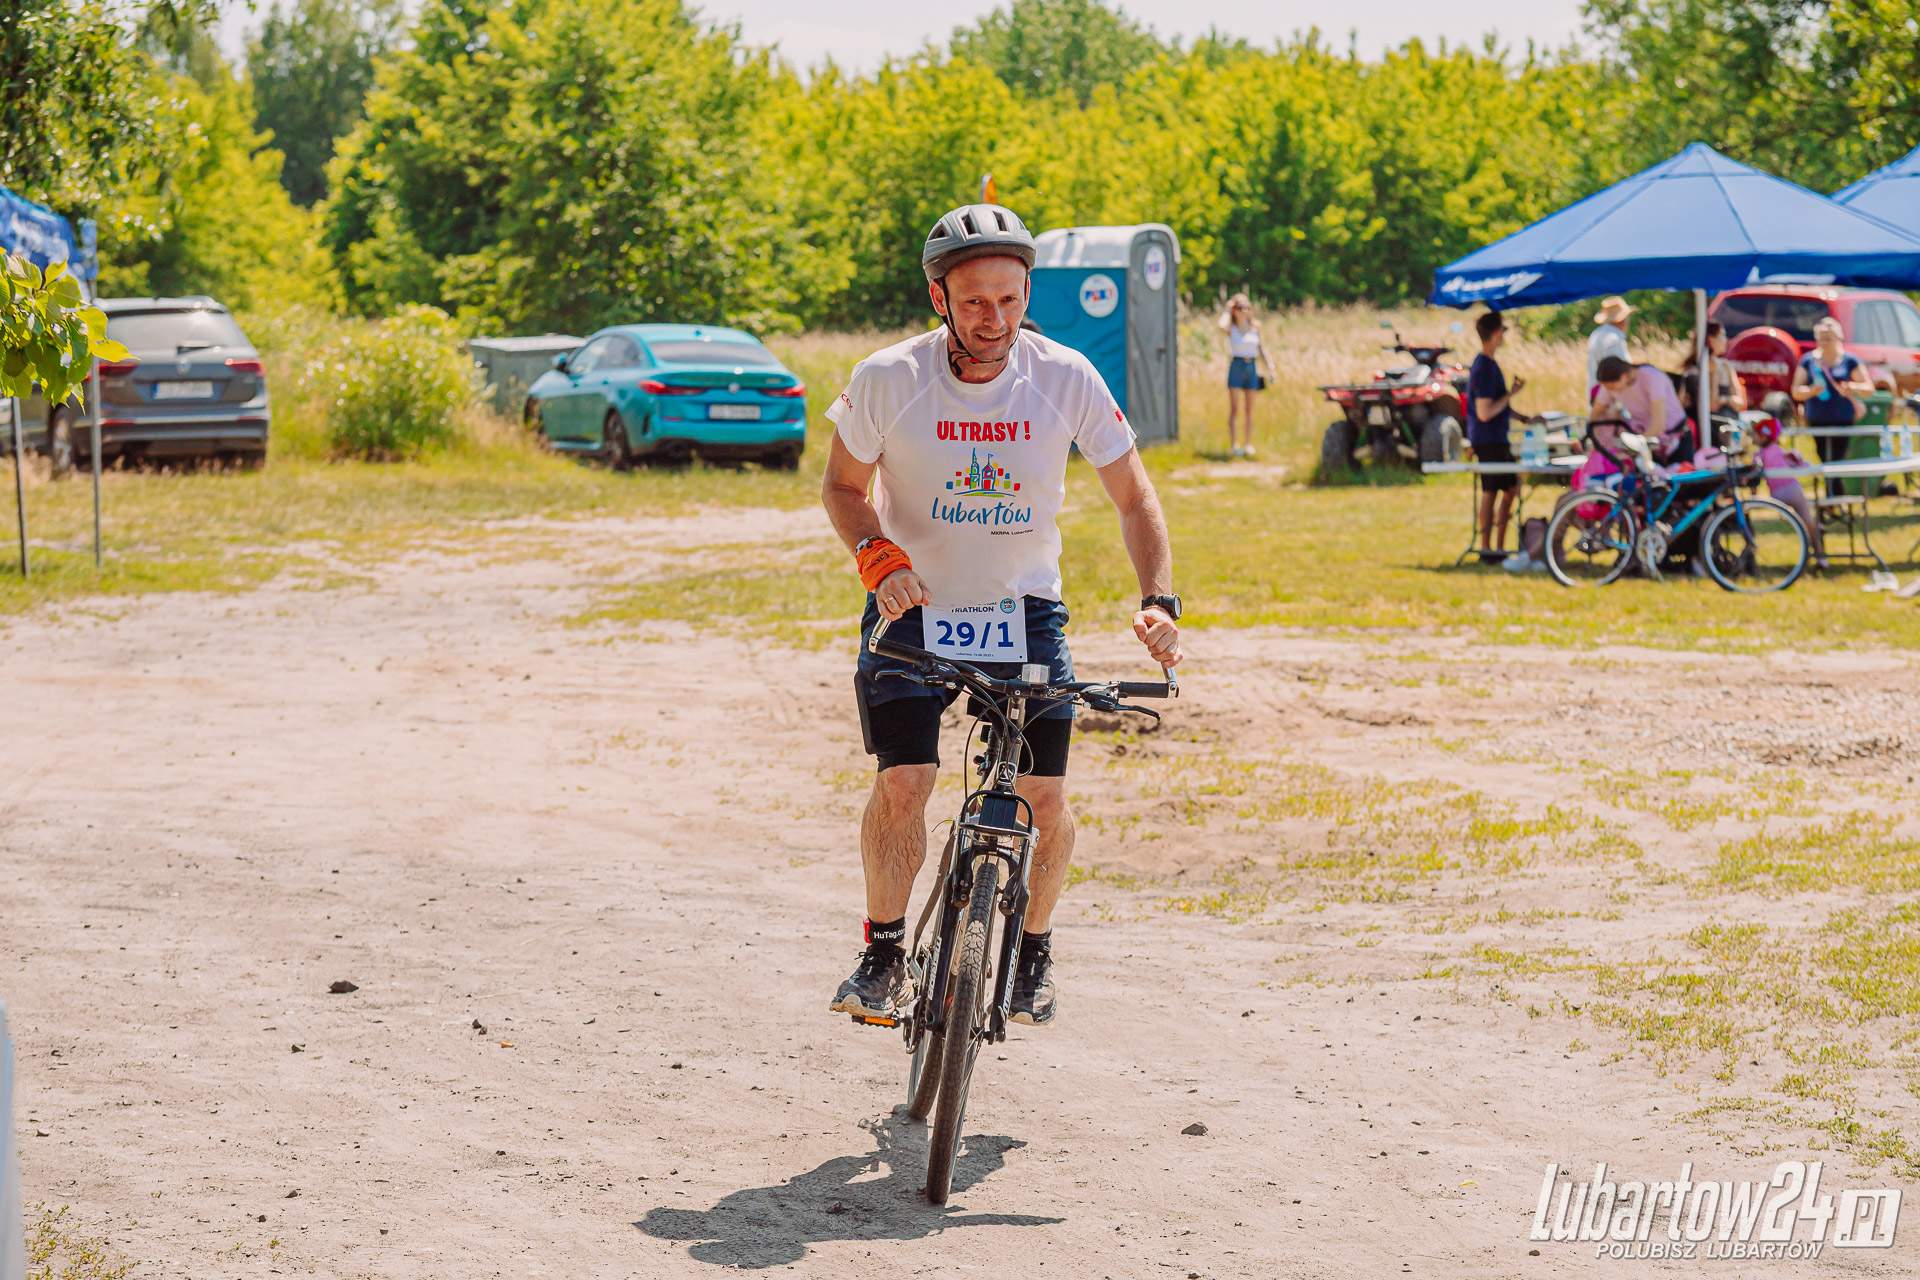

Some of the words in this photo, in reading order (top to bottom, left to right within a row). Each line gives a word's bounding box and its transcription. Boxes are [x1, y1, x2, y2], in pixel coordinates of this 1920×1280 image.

[936, 420, 1018, 442] ULTRASY
[932, 497, 1031, 525] Lubartów
[952, 606, 995, 614] RIATHLON
[936, 620, 1014, 649] 29/1
